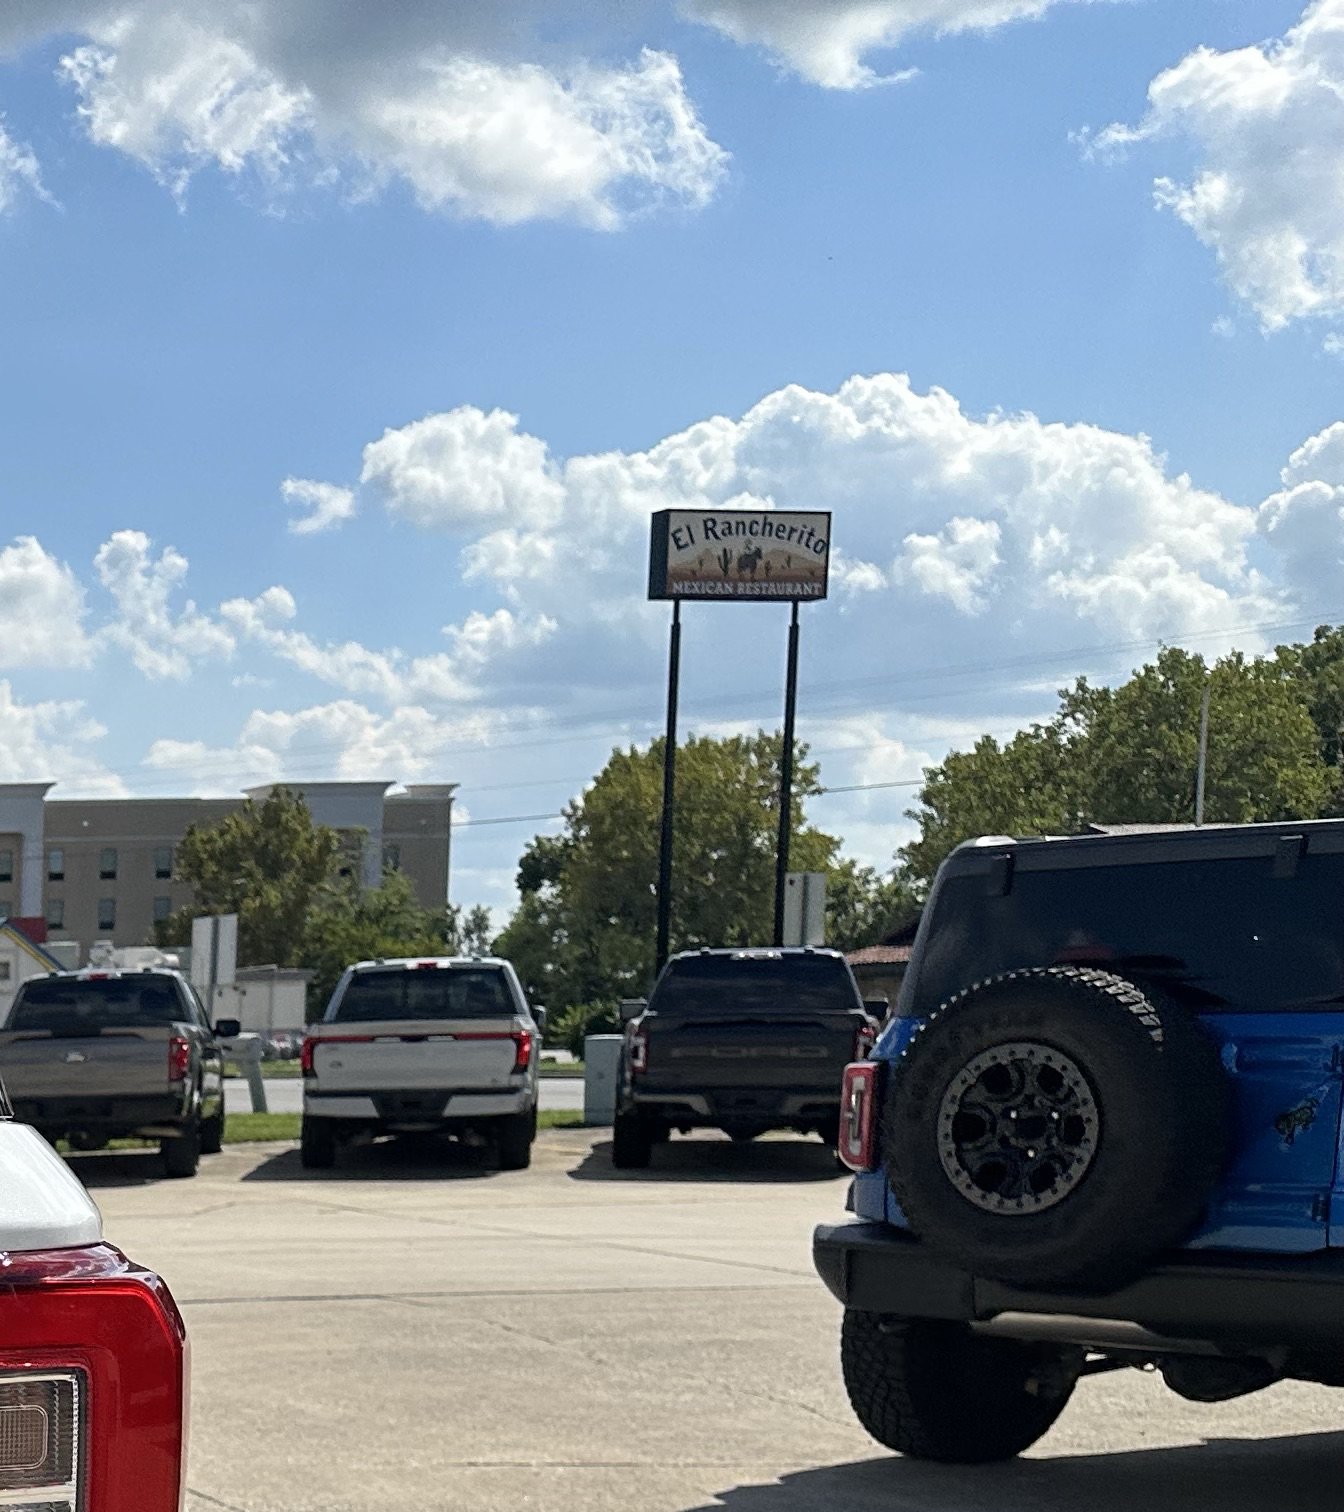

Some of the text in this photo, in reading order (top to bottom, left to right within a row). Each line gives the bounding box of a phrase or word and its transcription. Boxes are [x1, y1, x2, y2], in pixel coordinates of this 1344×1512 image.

[671, 515, 828, 556] El Rancherito
[671, 581, 823, 596] MEXICAN RESTAURANT
